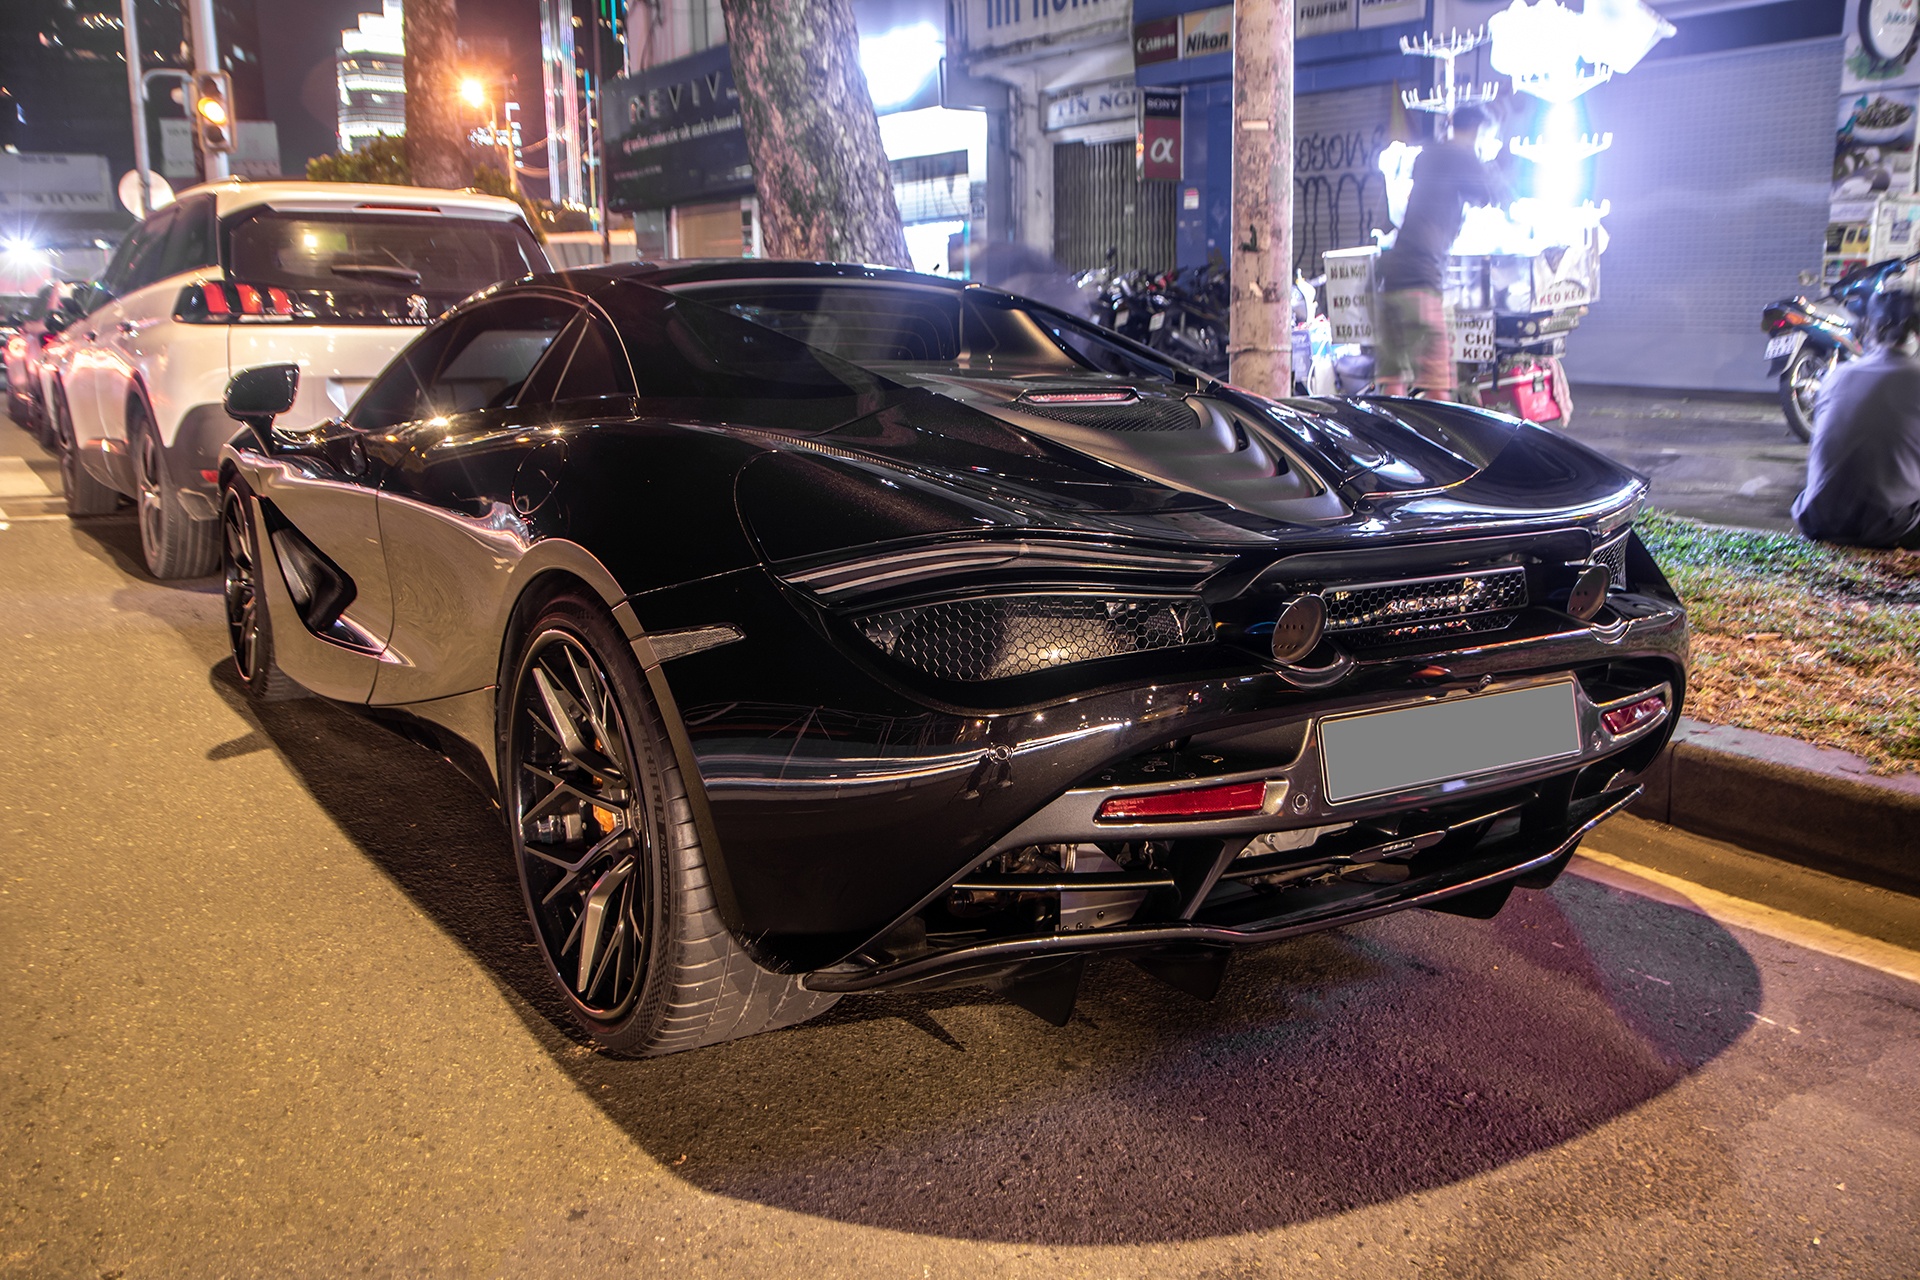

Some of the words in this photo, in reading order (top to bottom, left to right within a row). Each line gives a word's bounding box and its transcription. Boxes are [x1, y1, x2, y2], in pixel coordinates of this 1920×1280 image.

[1300, 2, 1348, 20] FUJIFILM
[1136, 33, 1176, 54] Canon
[1186, 31, 1229, 54] Nikon
[1146, 97, 1178, 111] SONY
[659, 833, 668, 864] PILOT
[661, 866, 670, 901] SPORT
